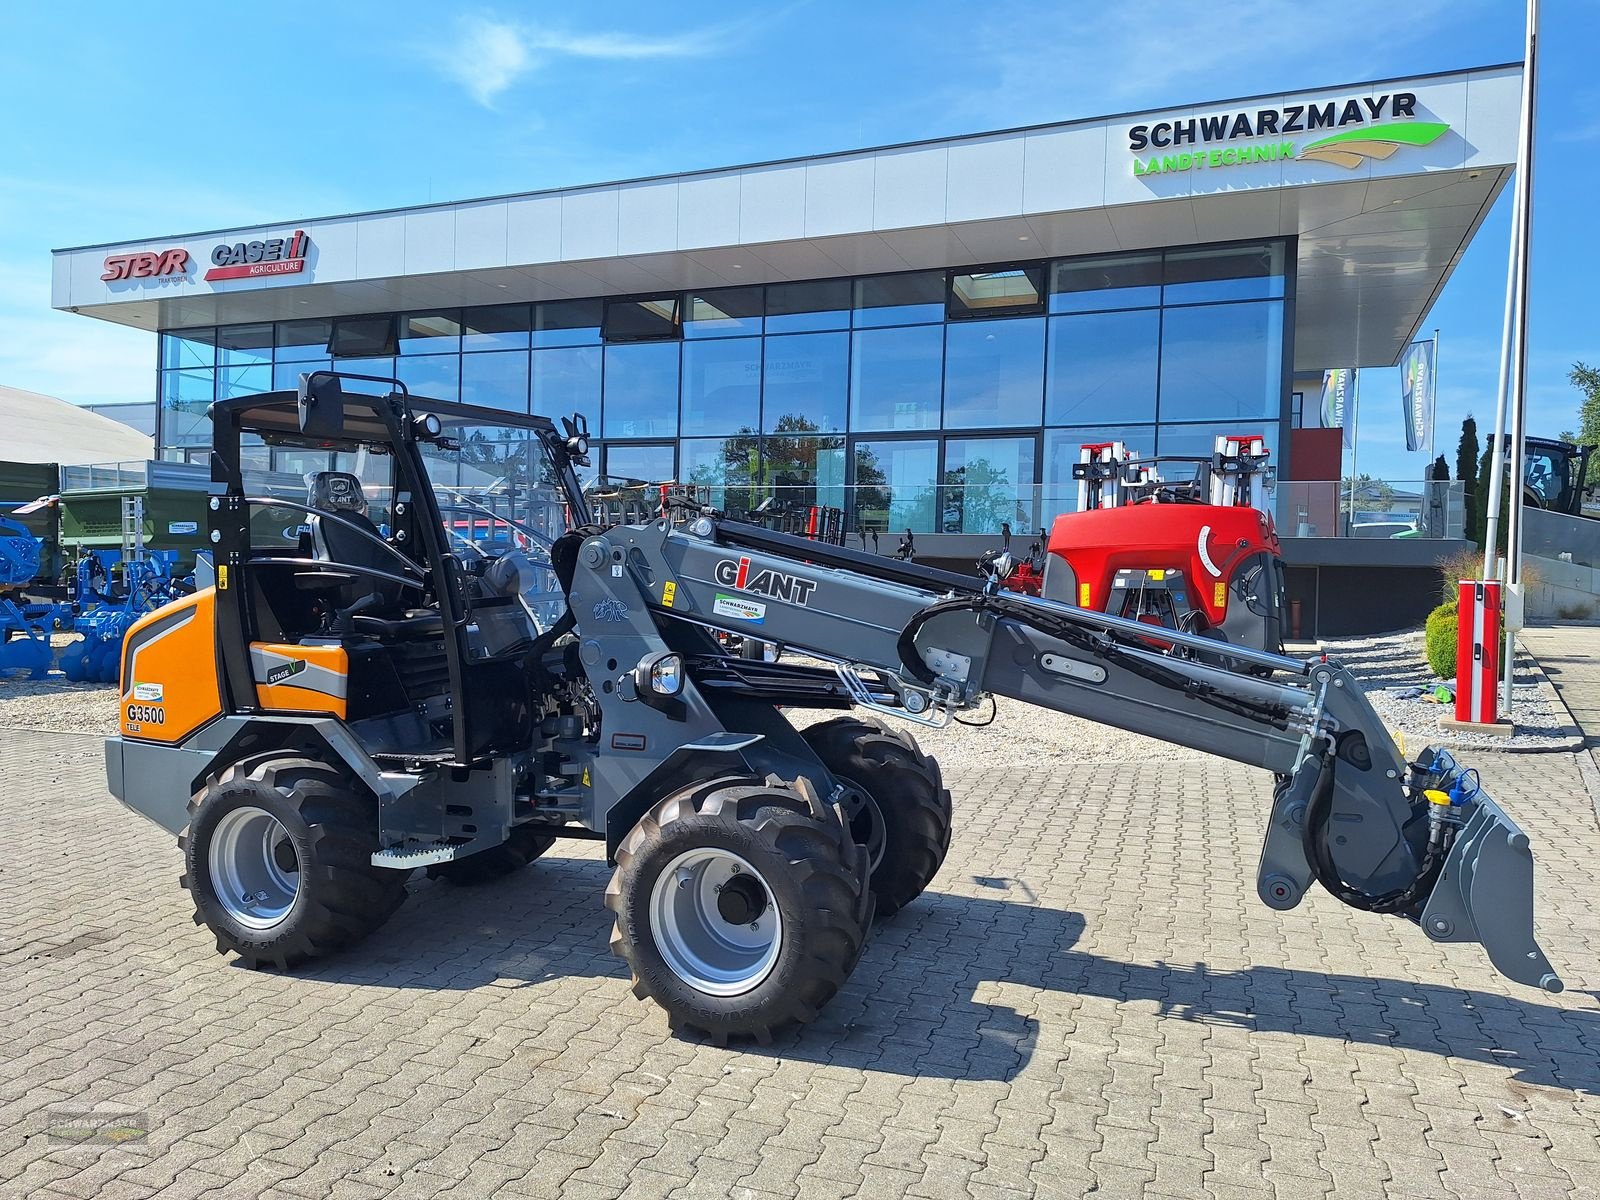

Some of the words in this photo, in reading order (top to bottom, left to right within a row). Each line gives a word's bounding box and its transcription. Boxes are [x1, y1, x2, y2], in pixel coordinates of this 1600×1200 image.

[1129, 92, 1417, 152] SCHWARZMAYR
[1133, 142, 1296, 177] LANDTECHNIK
[211, 238, 284, 266] CASE
[100, 248, 189, 281] STEYR
[249, 261, 299, 274] AGRICULTURE
[269, 669, 290, 683] STAGE
[127, 704, 165, 725] G3500
[126, 723, 141, 733] TELE
